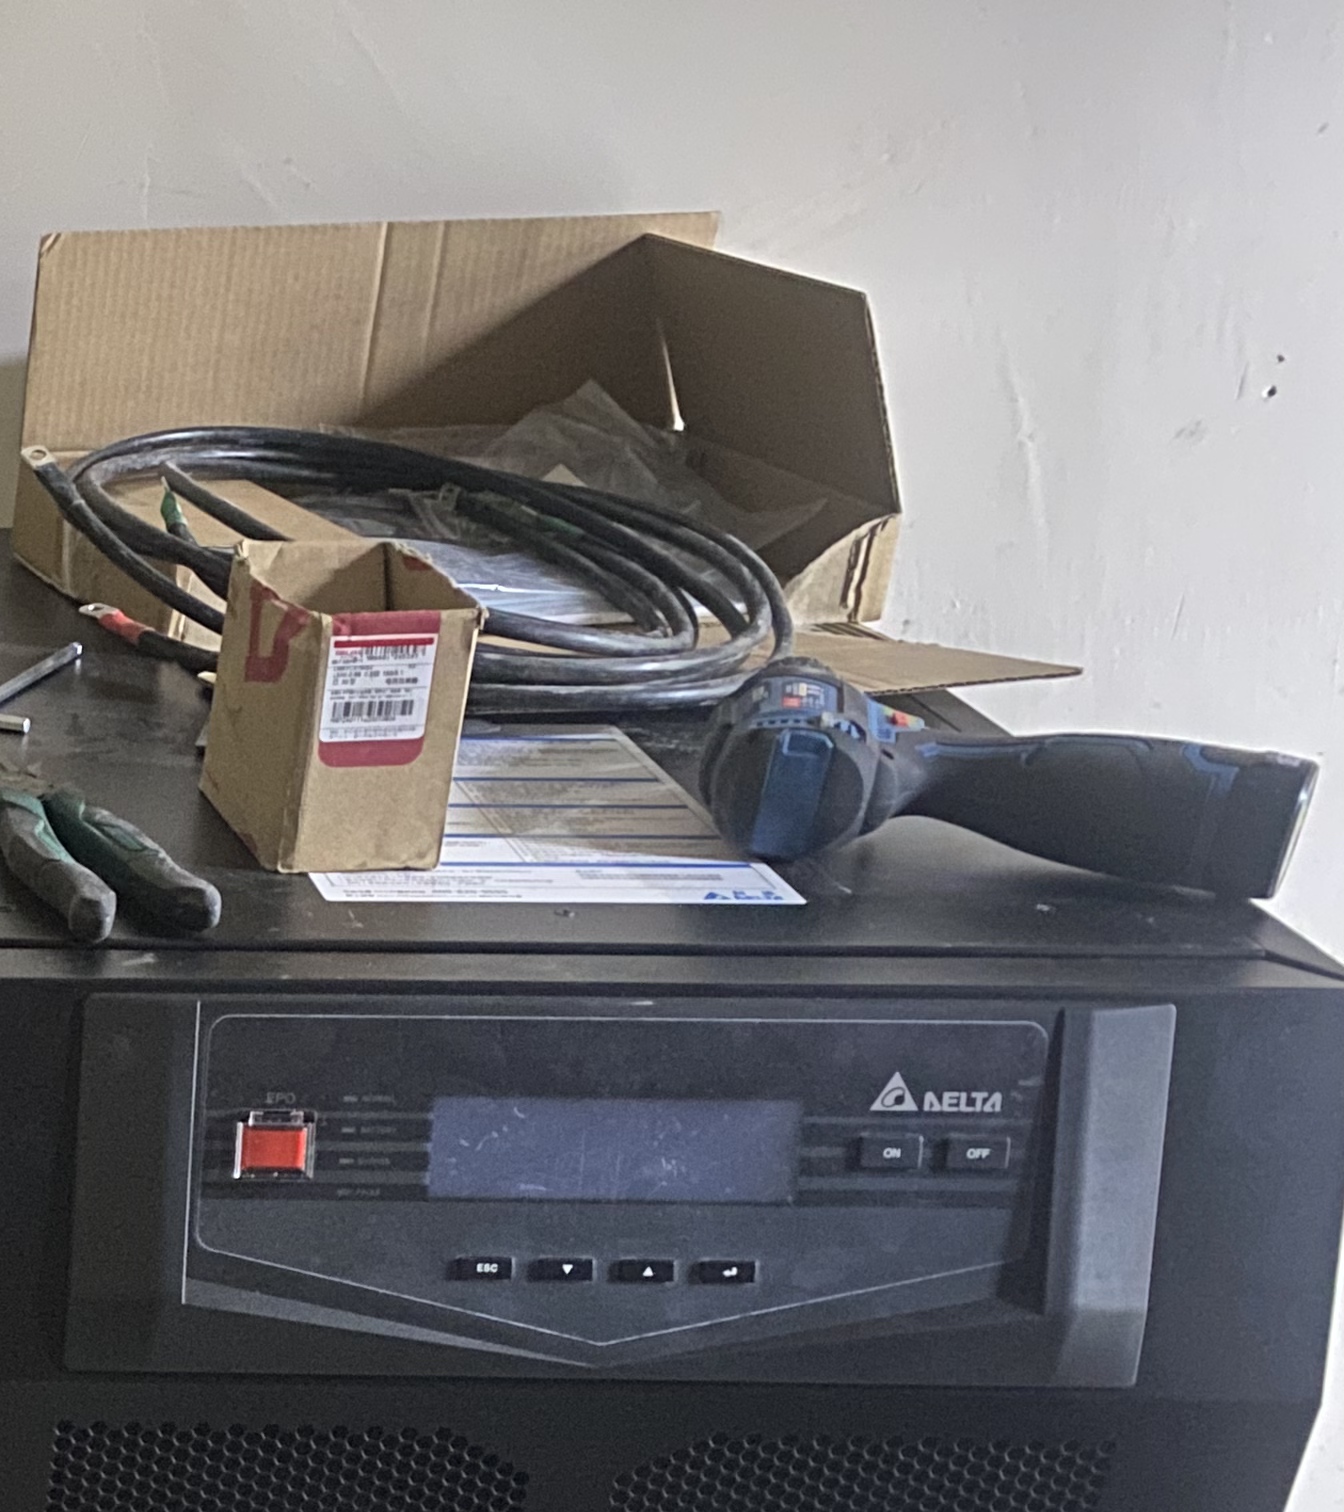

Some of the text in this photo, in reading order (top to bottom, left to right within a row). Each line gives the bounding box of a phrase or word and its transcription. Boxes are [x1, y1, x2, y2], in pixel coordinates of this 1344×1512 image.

[266, 1092, 296, 1105] EPO
[923, 1091, 1003, 1112] DELTA
[882, 1147, 902, 1159] ON
[966, 1148, 991, 1159] OFF
[476, 1262, 499, 1274] ESC
